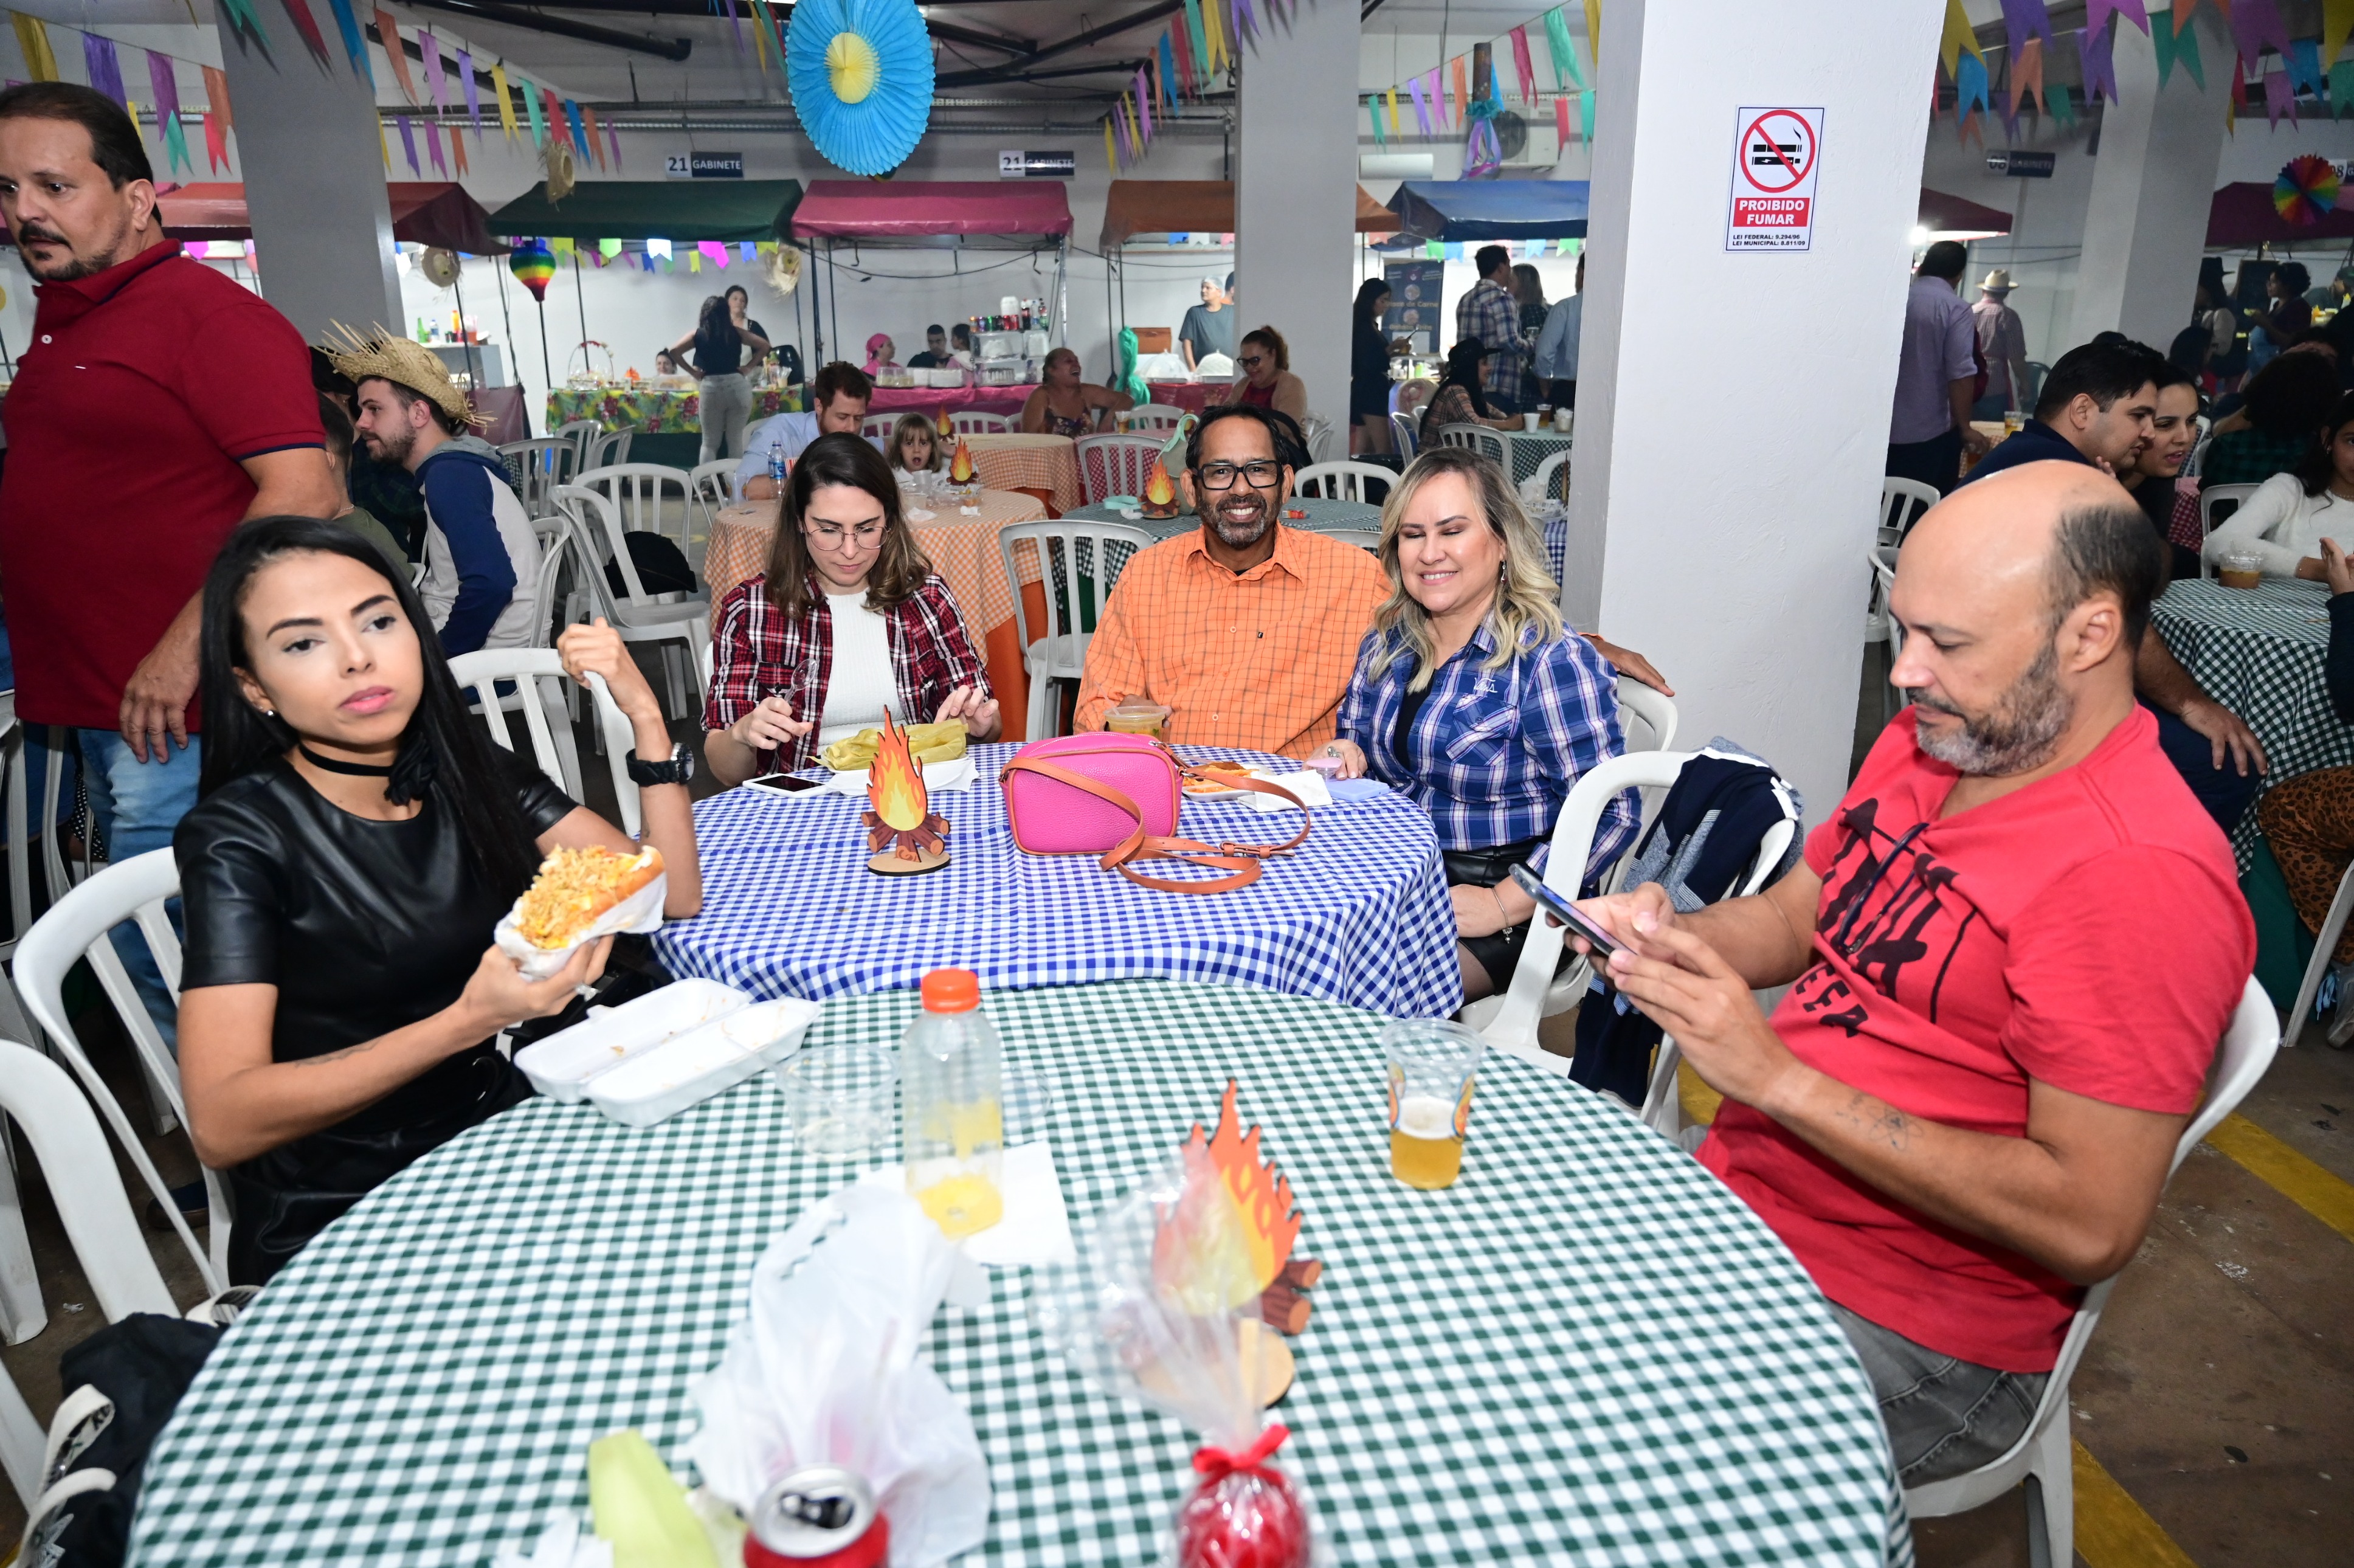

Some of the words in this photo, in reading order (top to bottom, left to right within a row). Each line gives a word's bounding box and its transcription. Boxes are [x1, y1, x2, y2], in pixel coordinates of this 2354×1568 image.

[669, 157, 688, 171] 21
[692, 159, 742, 170] GABINETE
[1003, 157, 1022, 171] 21
[1739, 200, 1804, 211] PROIBIDO
[1747, 214, 1795, 225] FUMAR
